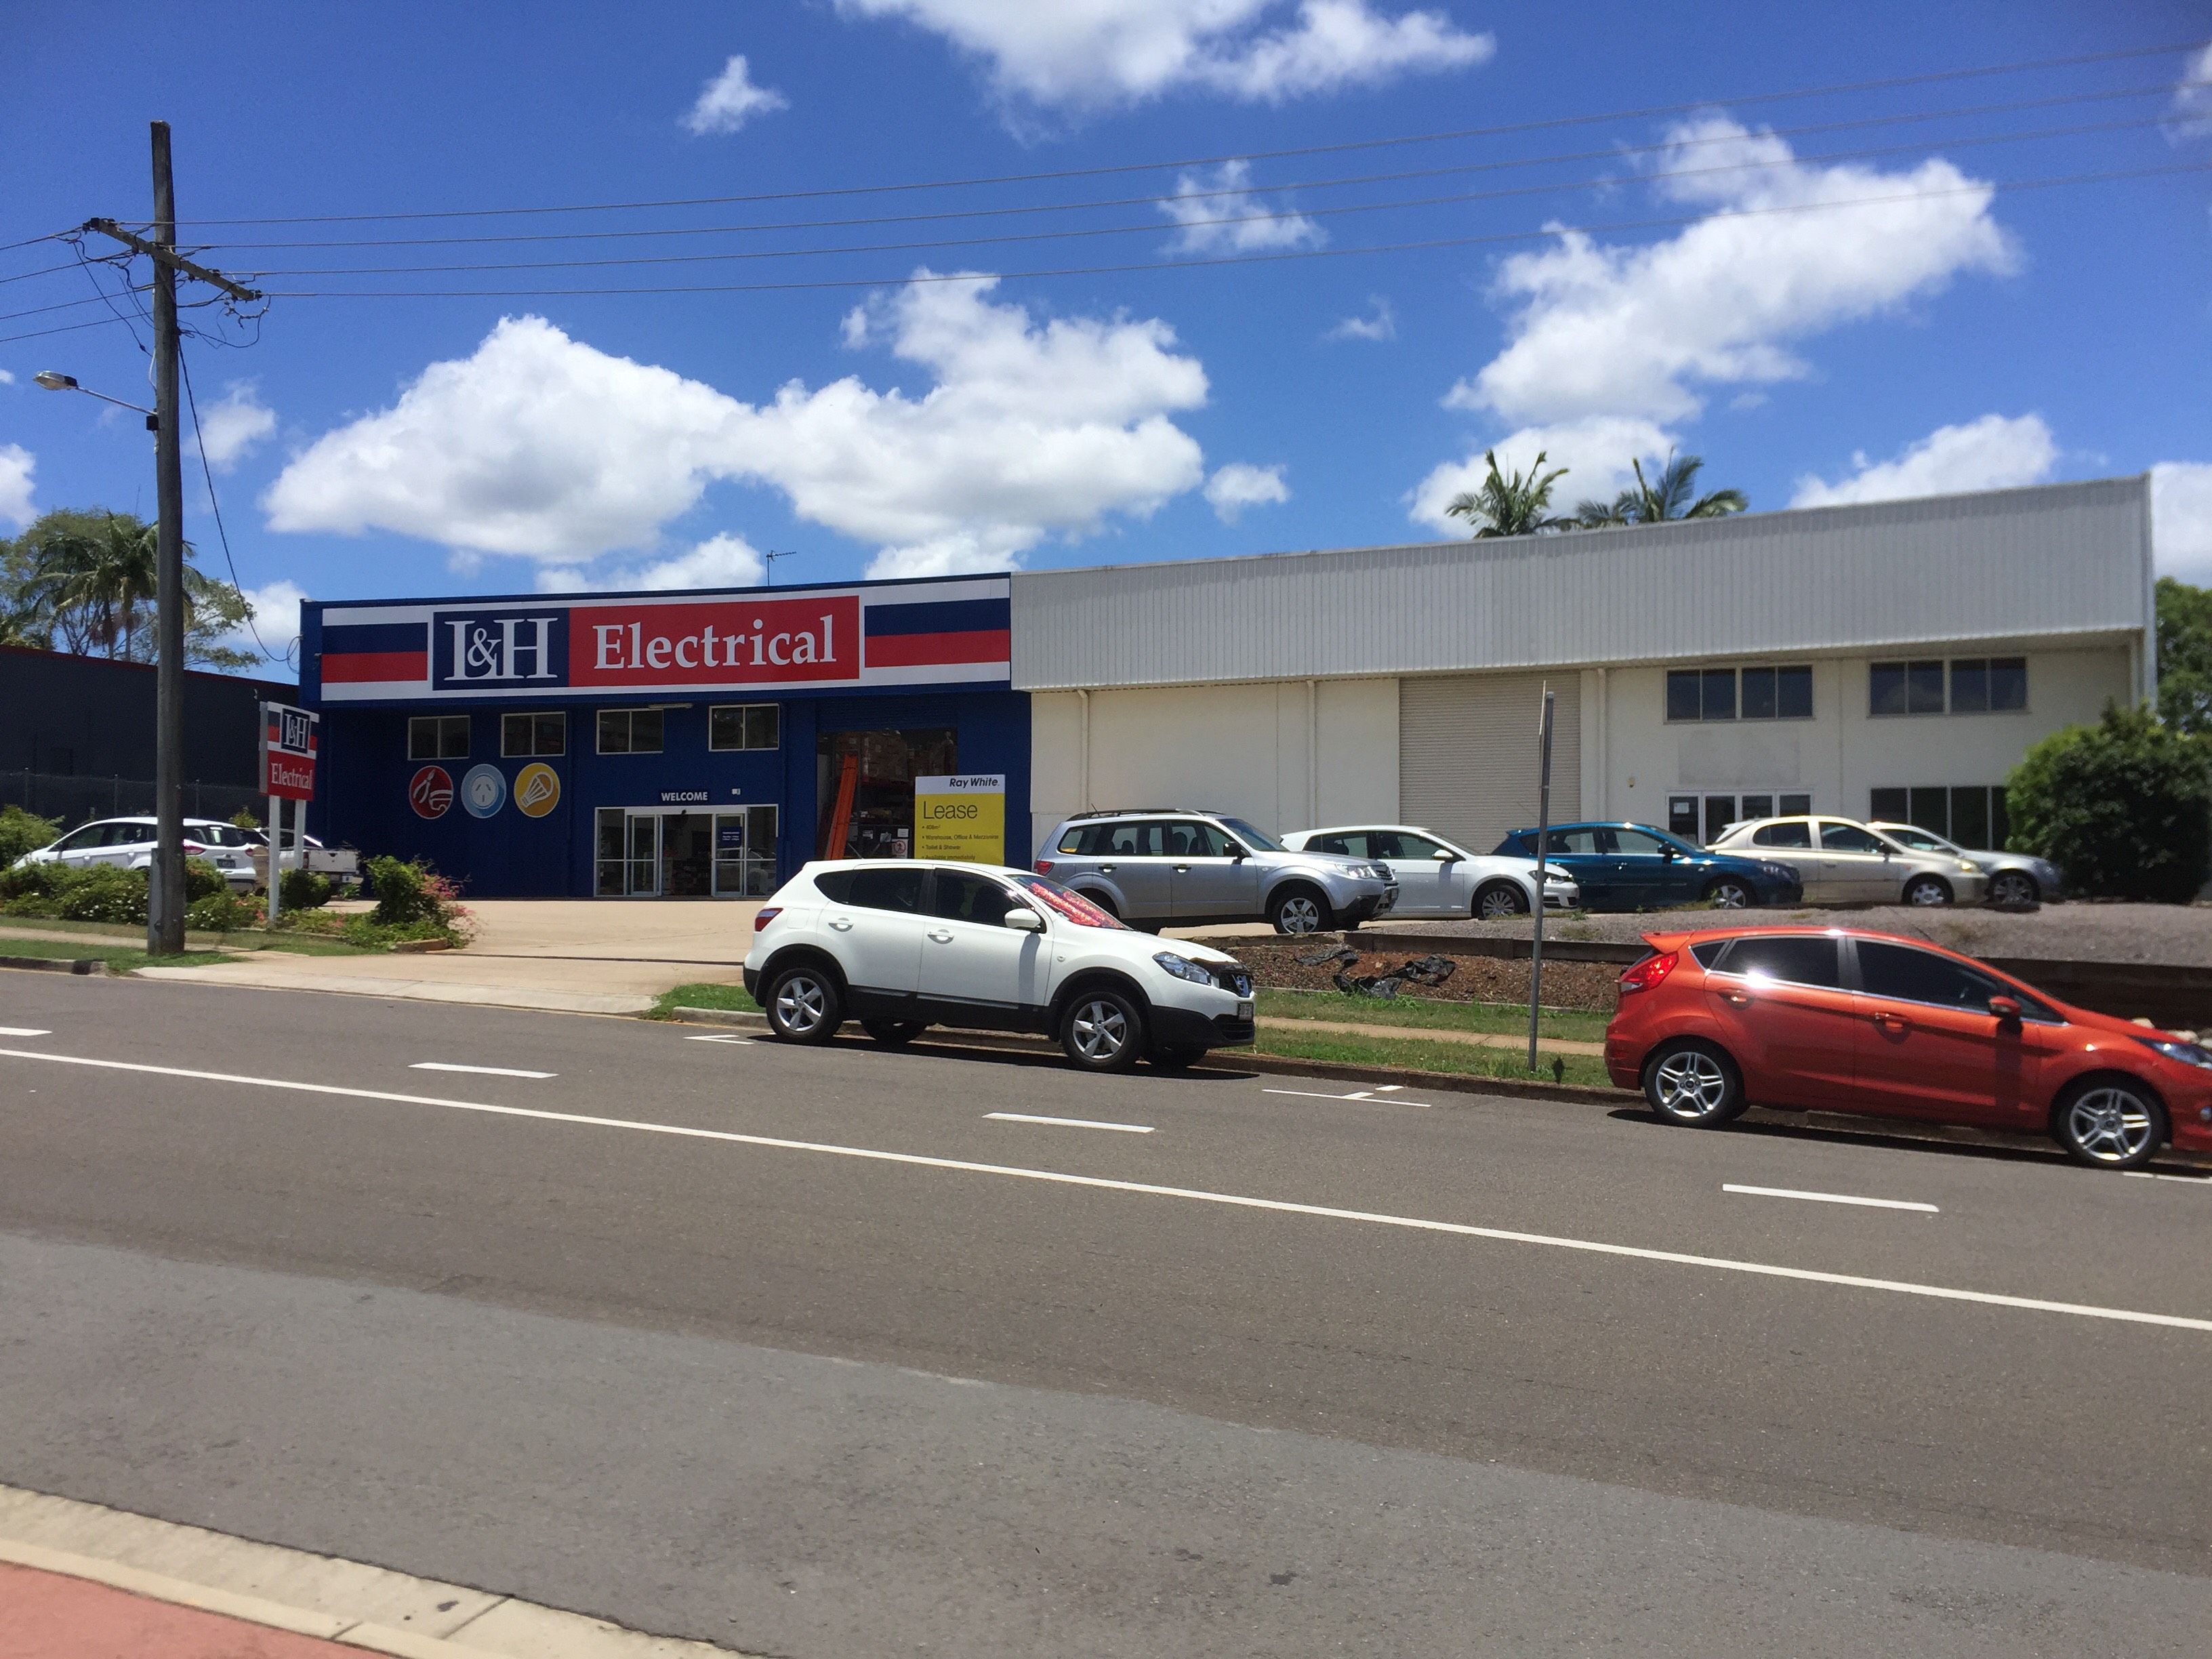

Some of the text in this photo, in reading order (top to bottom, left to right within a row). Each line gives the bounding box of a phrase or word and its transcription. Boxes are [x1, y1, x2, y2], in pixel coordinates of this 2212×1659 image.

[592, 613, 837, 670] Electrical
[271, 762, 313, 790] Electrical
[949, 777, 998, 788] Ray White
[661, 792, 708, 801] WELCOME
[923, 801, 977, 819] Lease
